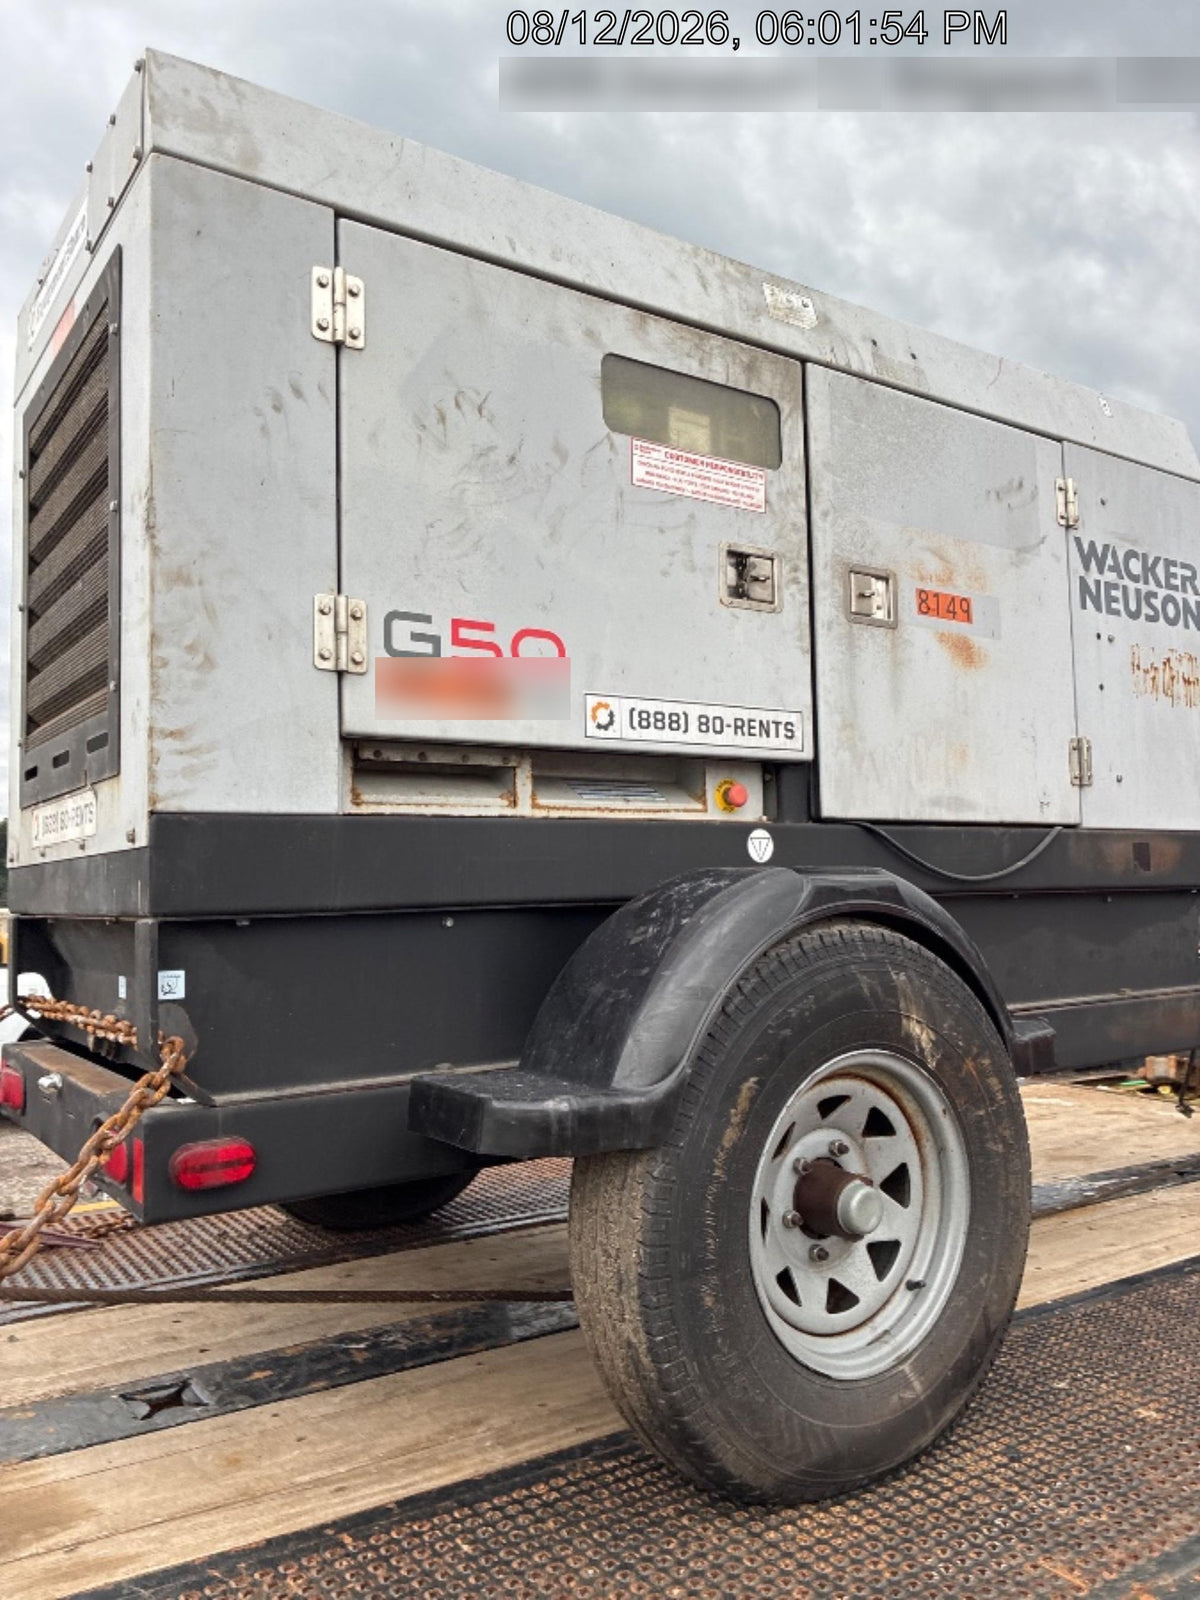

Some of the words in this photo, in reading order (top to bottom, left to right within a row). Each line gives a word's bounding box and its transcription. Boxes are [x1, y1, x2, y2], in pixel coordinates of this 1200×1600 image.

[1073, 536, 1200, 597] WACKER
[1079, 575, 1200, 632] NEUSON
[629, 707, 689, 733] (888)
[698, 714, 796, 740] 80-RENTS
